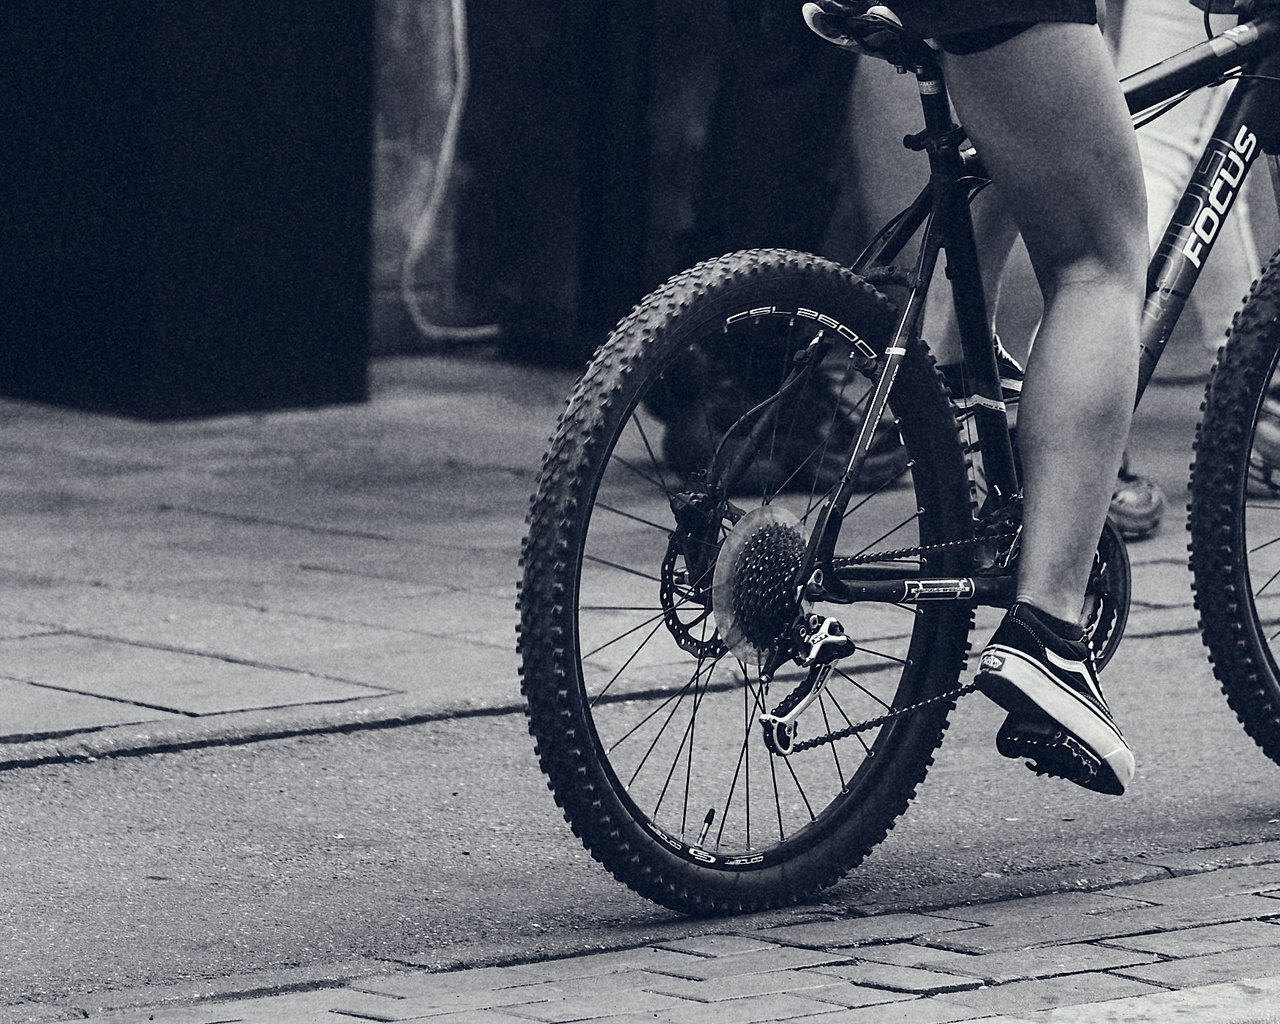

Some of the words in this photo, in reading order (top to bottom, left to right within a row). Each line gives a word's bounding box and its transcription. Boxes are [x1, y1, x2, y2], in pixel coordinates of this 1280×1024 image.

[1182, 124, 1257, 269] FOCUS
[726, 306, 792, 324] CSL
[796, 307, 878, 360] 2600
